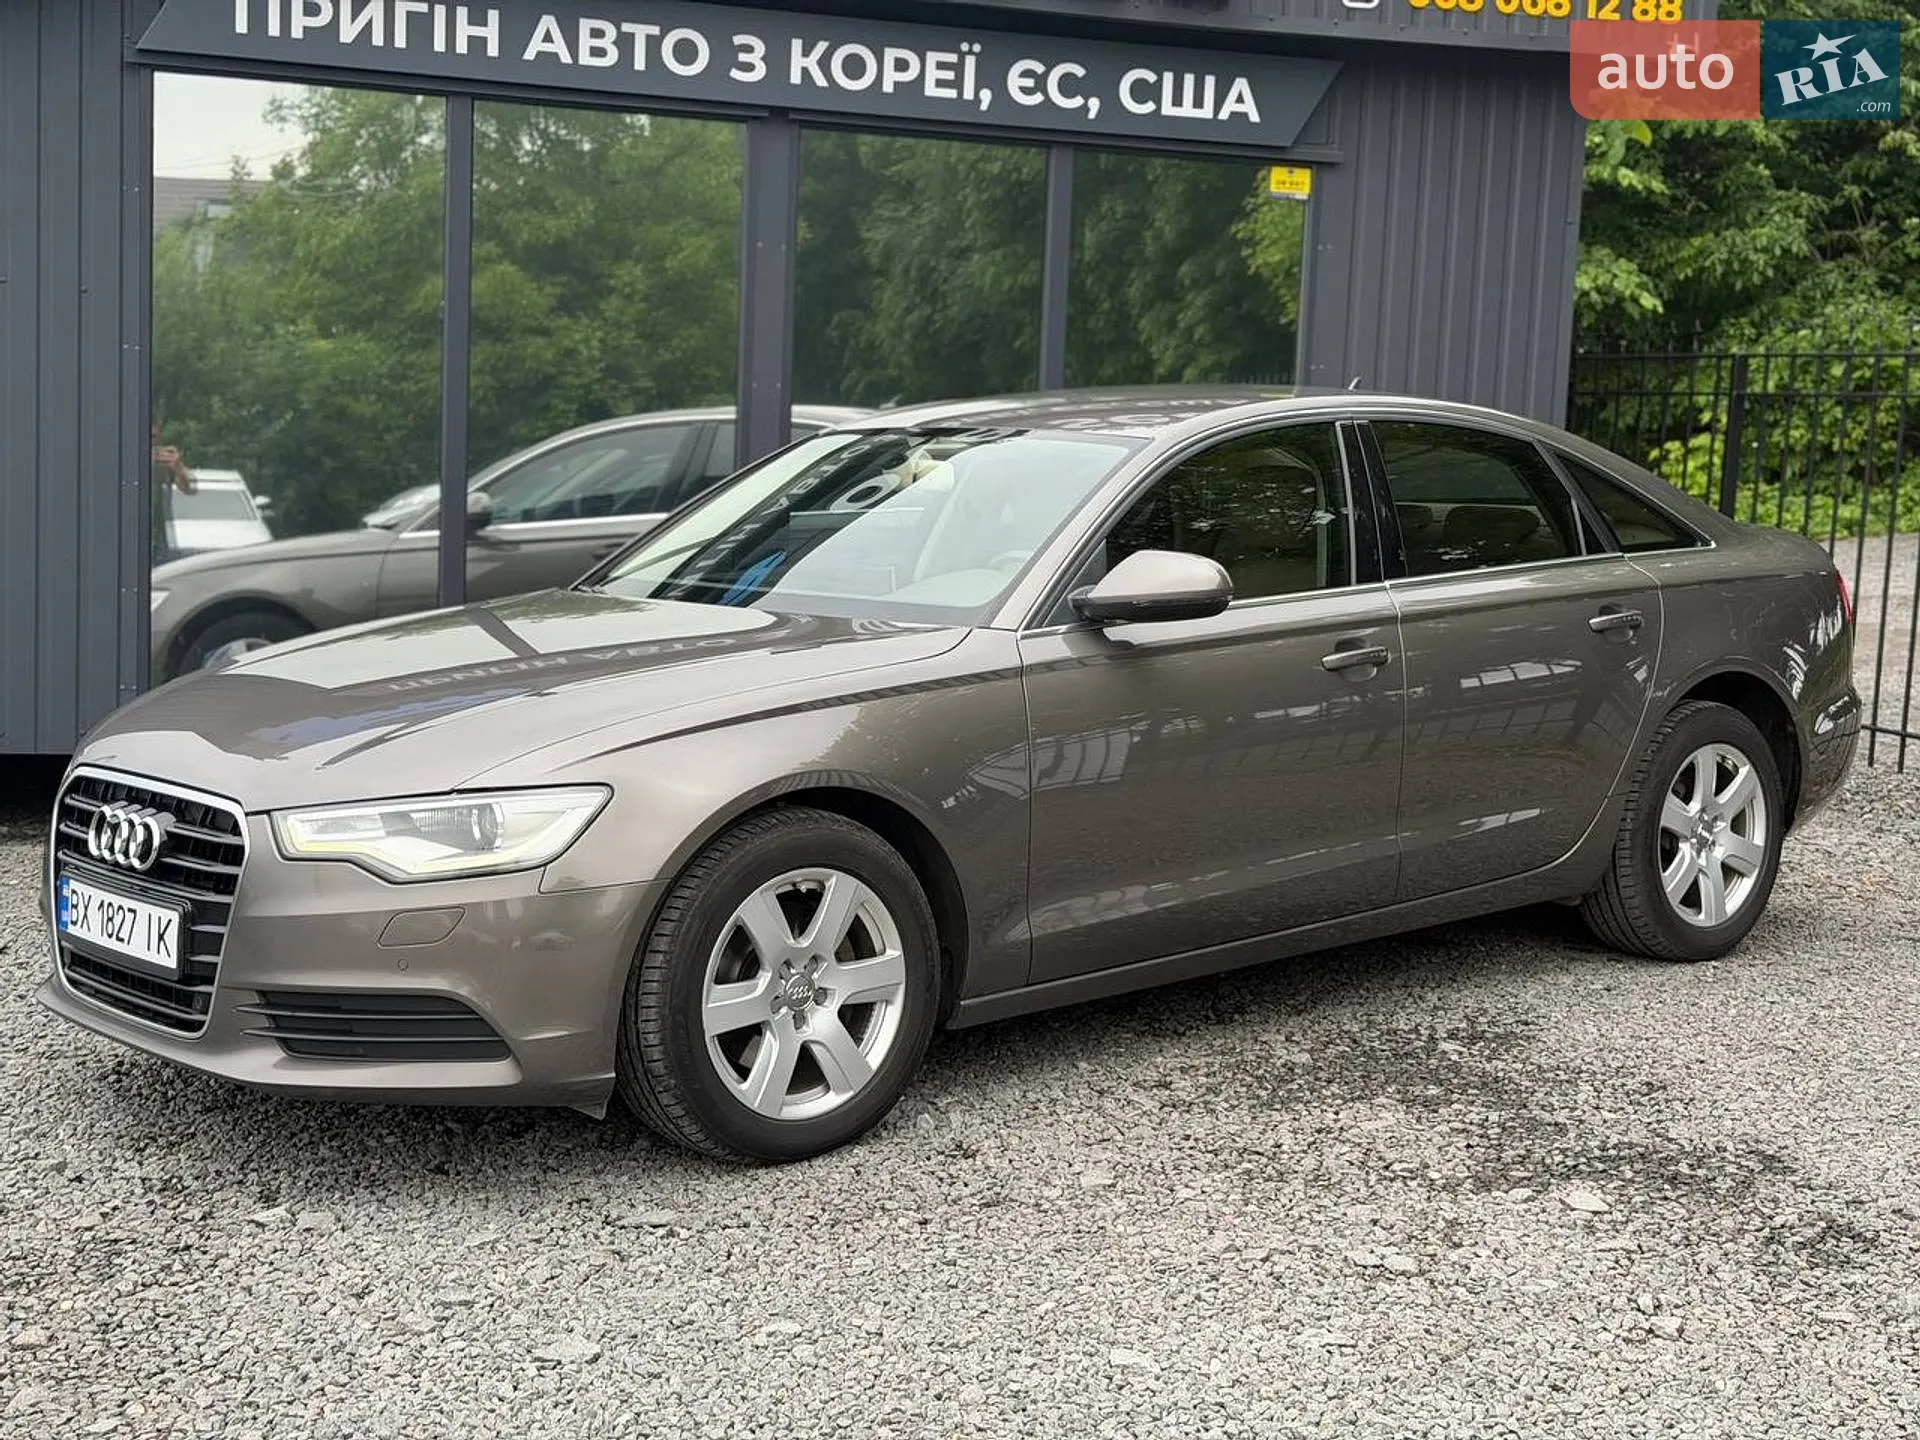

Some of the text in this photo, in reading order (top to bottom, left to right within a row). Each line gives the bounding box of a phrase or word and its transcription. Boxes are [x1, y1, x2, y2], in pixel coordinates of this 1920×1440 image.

[522, 14, 711, 77] АВТО
[728, 34, 767, 83] З
[789, 37, 993, 112] КОРЕЇ,
[1006, 58, 1101, 120] ЄС,
[1118, 67, 1261, 123] США
[70, 888, 173, 958] BX 1827 IK
